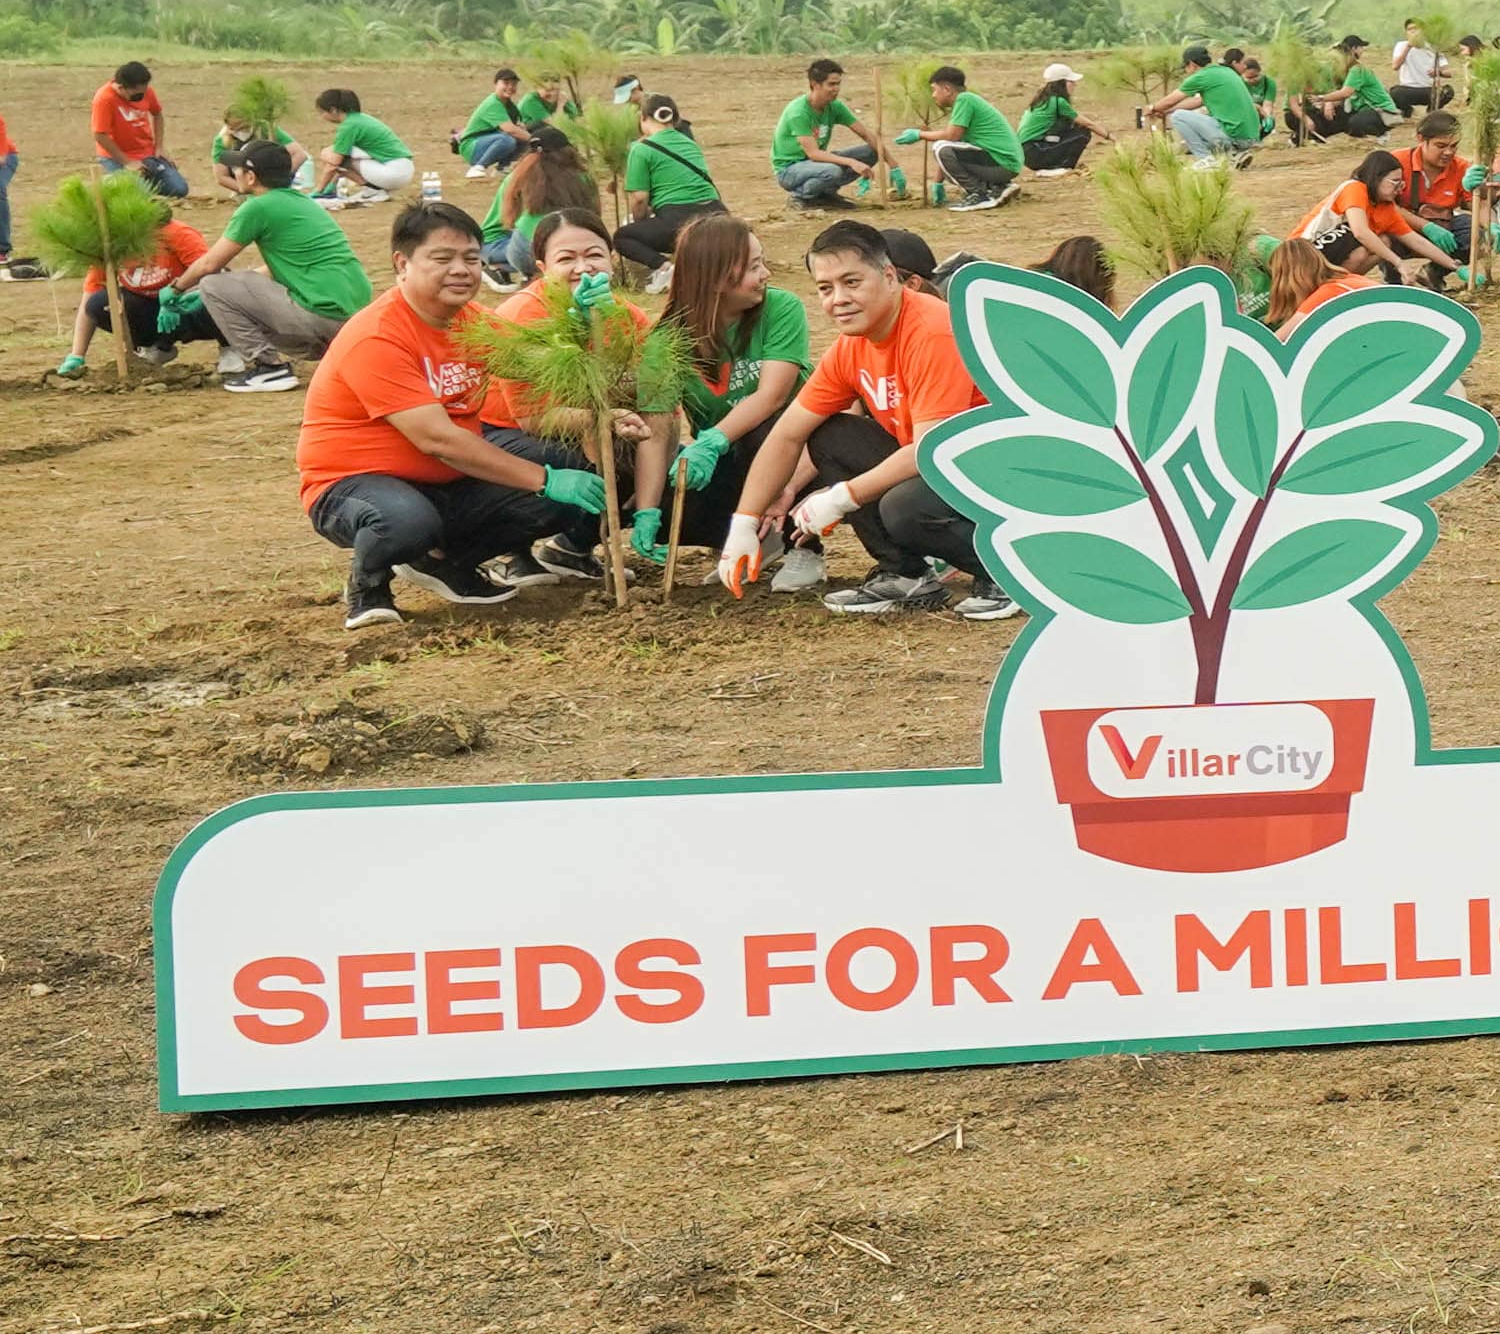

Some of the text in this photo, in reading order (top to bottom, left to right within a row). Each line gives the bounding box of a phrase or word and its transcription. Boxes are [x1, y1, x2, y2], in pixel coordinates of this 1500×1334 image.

[234, 939, 703, 1044] SEEDS
[745, 925, 1011, 1016] FOR
[1043, 919, 1140, 999] A
